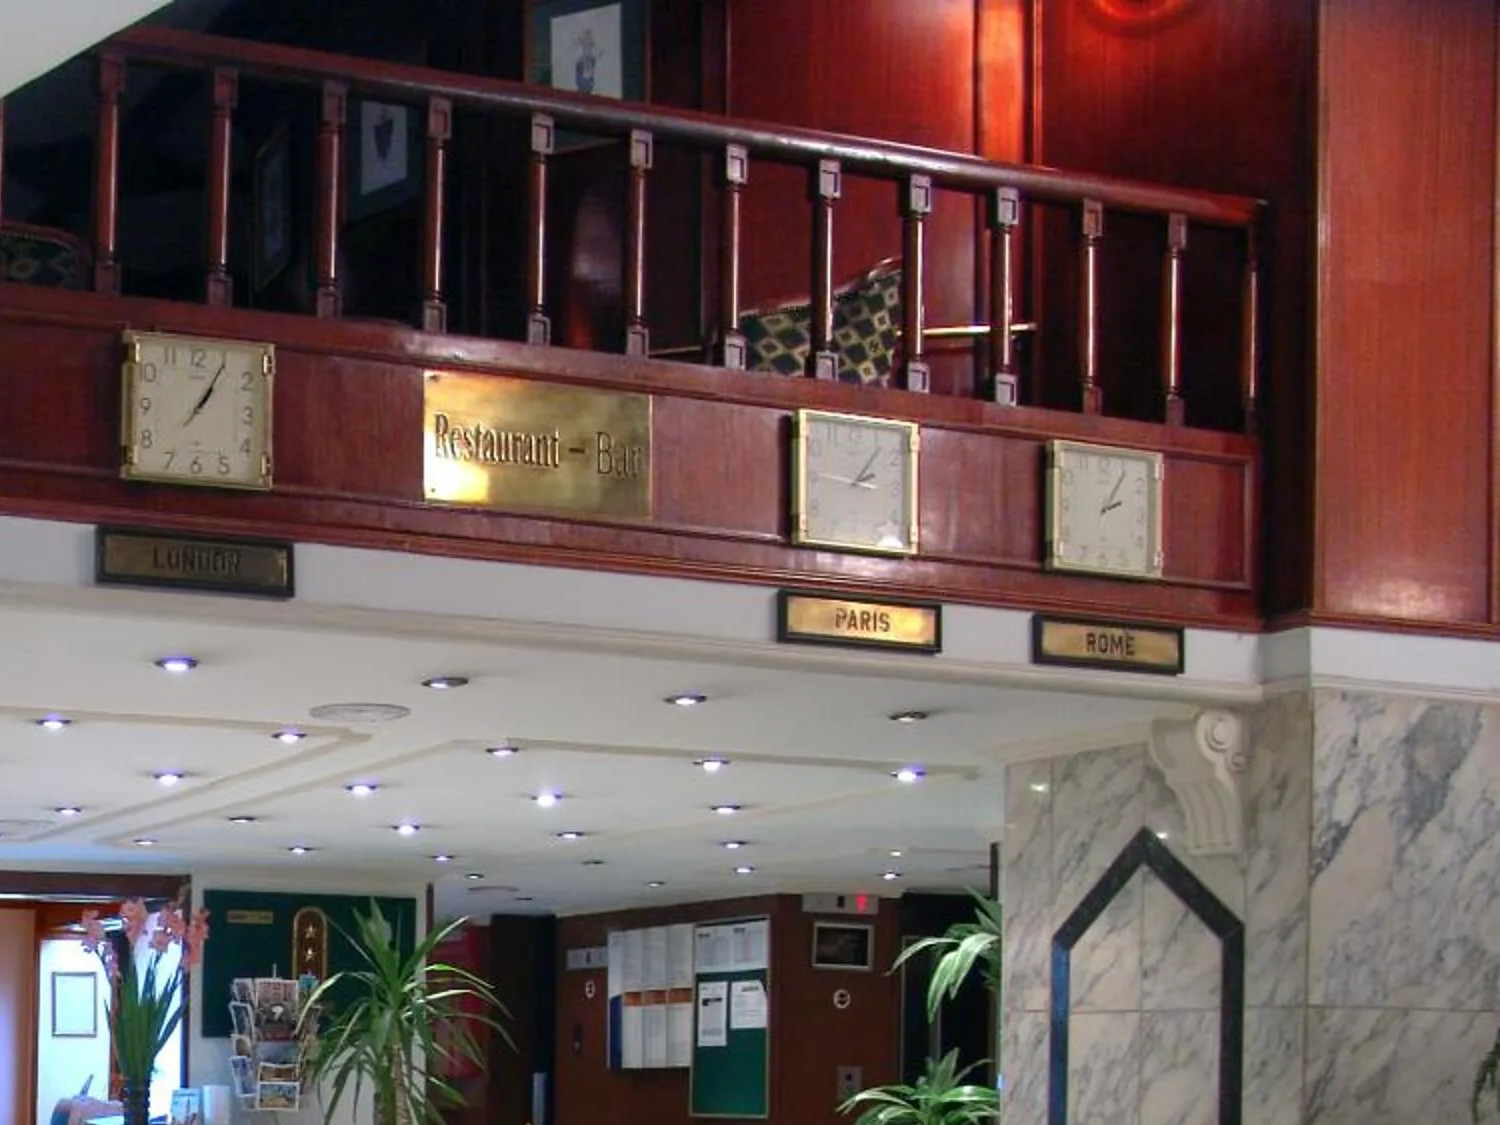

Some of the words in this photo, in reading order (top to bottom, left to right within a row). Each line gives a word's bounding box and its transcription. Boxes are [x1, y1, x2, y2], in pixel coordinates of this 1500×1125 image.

[164, 347, 177, 365] 11
[191, 348, 206, 368] 12
[241, 371, 254, 391] 2
[140, 397, 151, 415] 9
[242, 406, 254, 425] 3
[140, 429, 152, 449] 8
[240, 438, 251, 457] 4
[434, 412, 560, 468] Restaurant
[595, 431, 642, 478] Bar
[164, 451, 175, 470] 7
[190, 456, 203, 475] 6
[217, 455, 230, 475] 5
[152, 545, 240, 575] LONDON
[835, 608, 891, 632] PARIS
[1086, 632, 1136, 656] ROME
